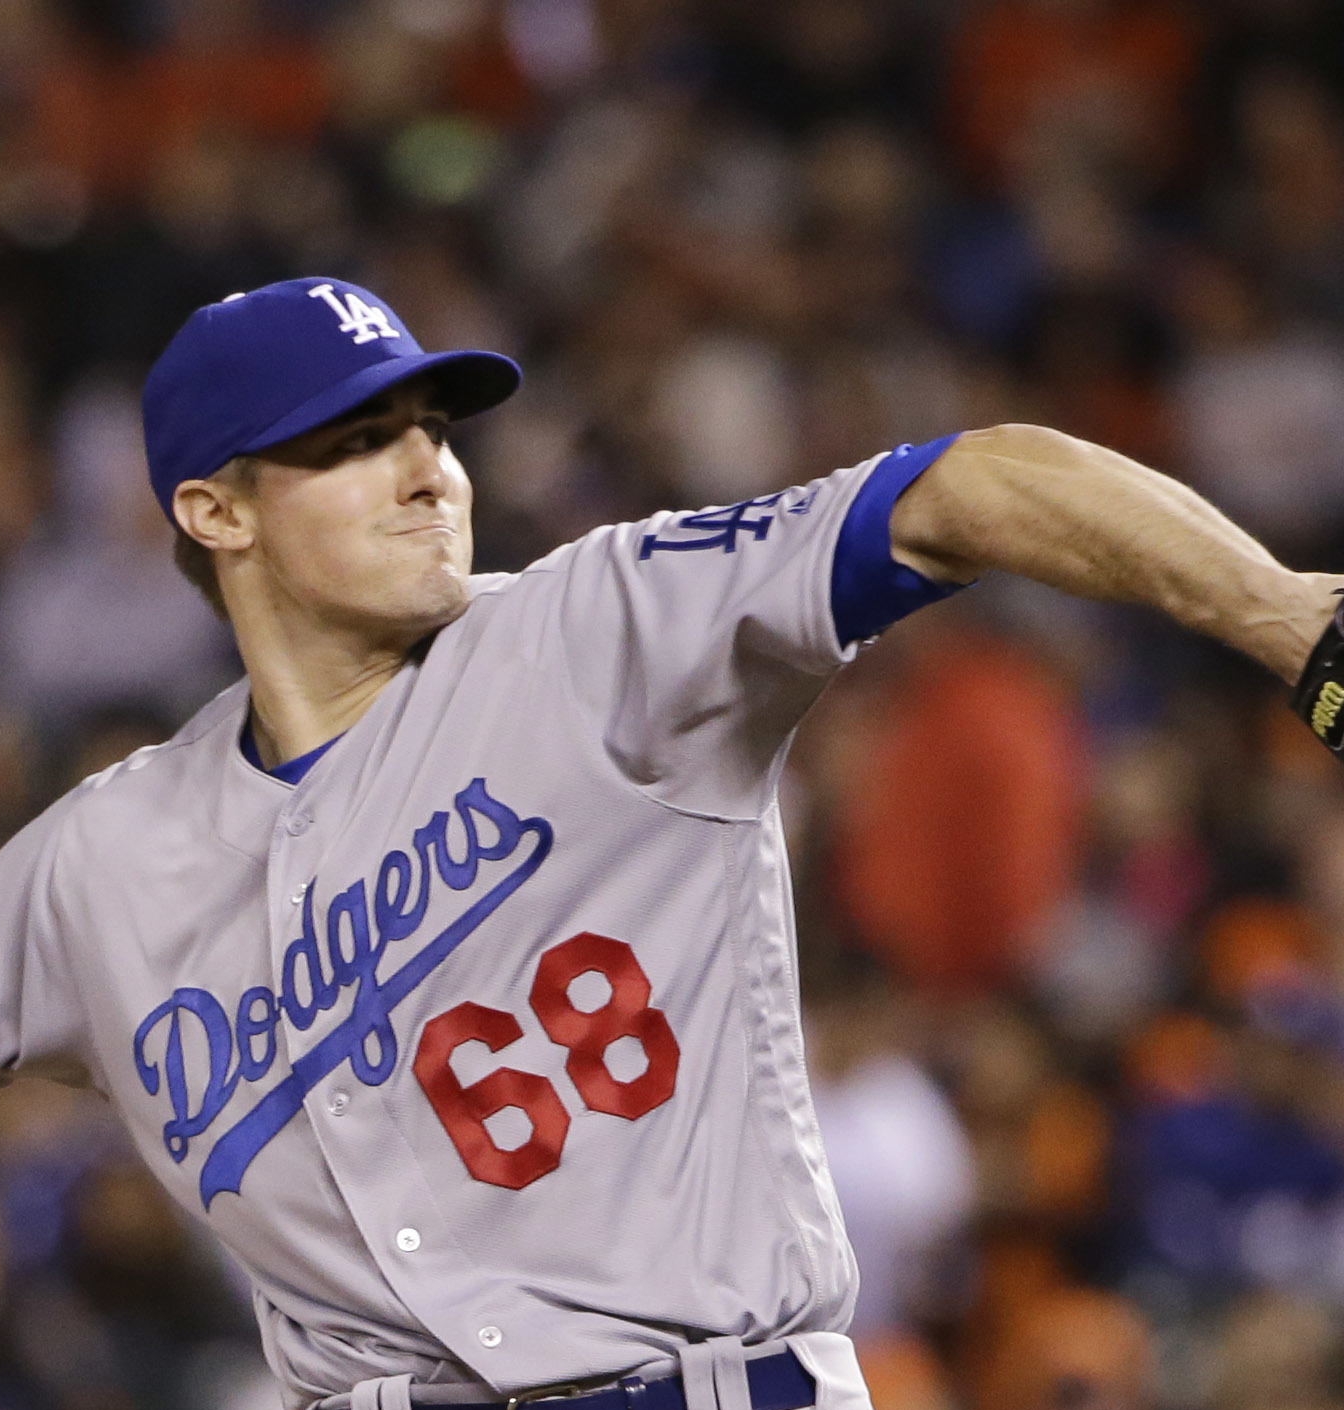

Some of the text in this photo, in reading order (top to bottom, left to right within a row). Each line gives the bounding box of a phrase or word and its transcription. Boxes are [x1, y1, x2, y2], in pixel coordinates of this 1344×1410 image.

[307, 283, 401, 344] LA
[134, 777, 554, 1190] Dodgers
[413, 931, 681, 1191] 68
